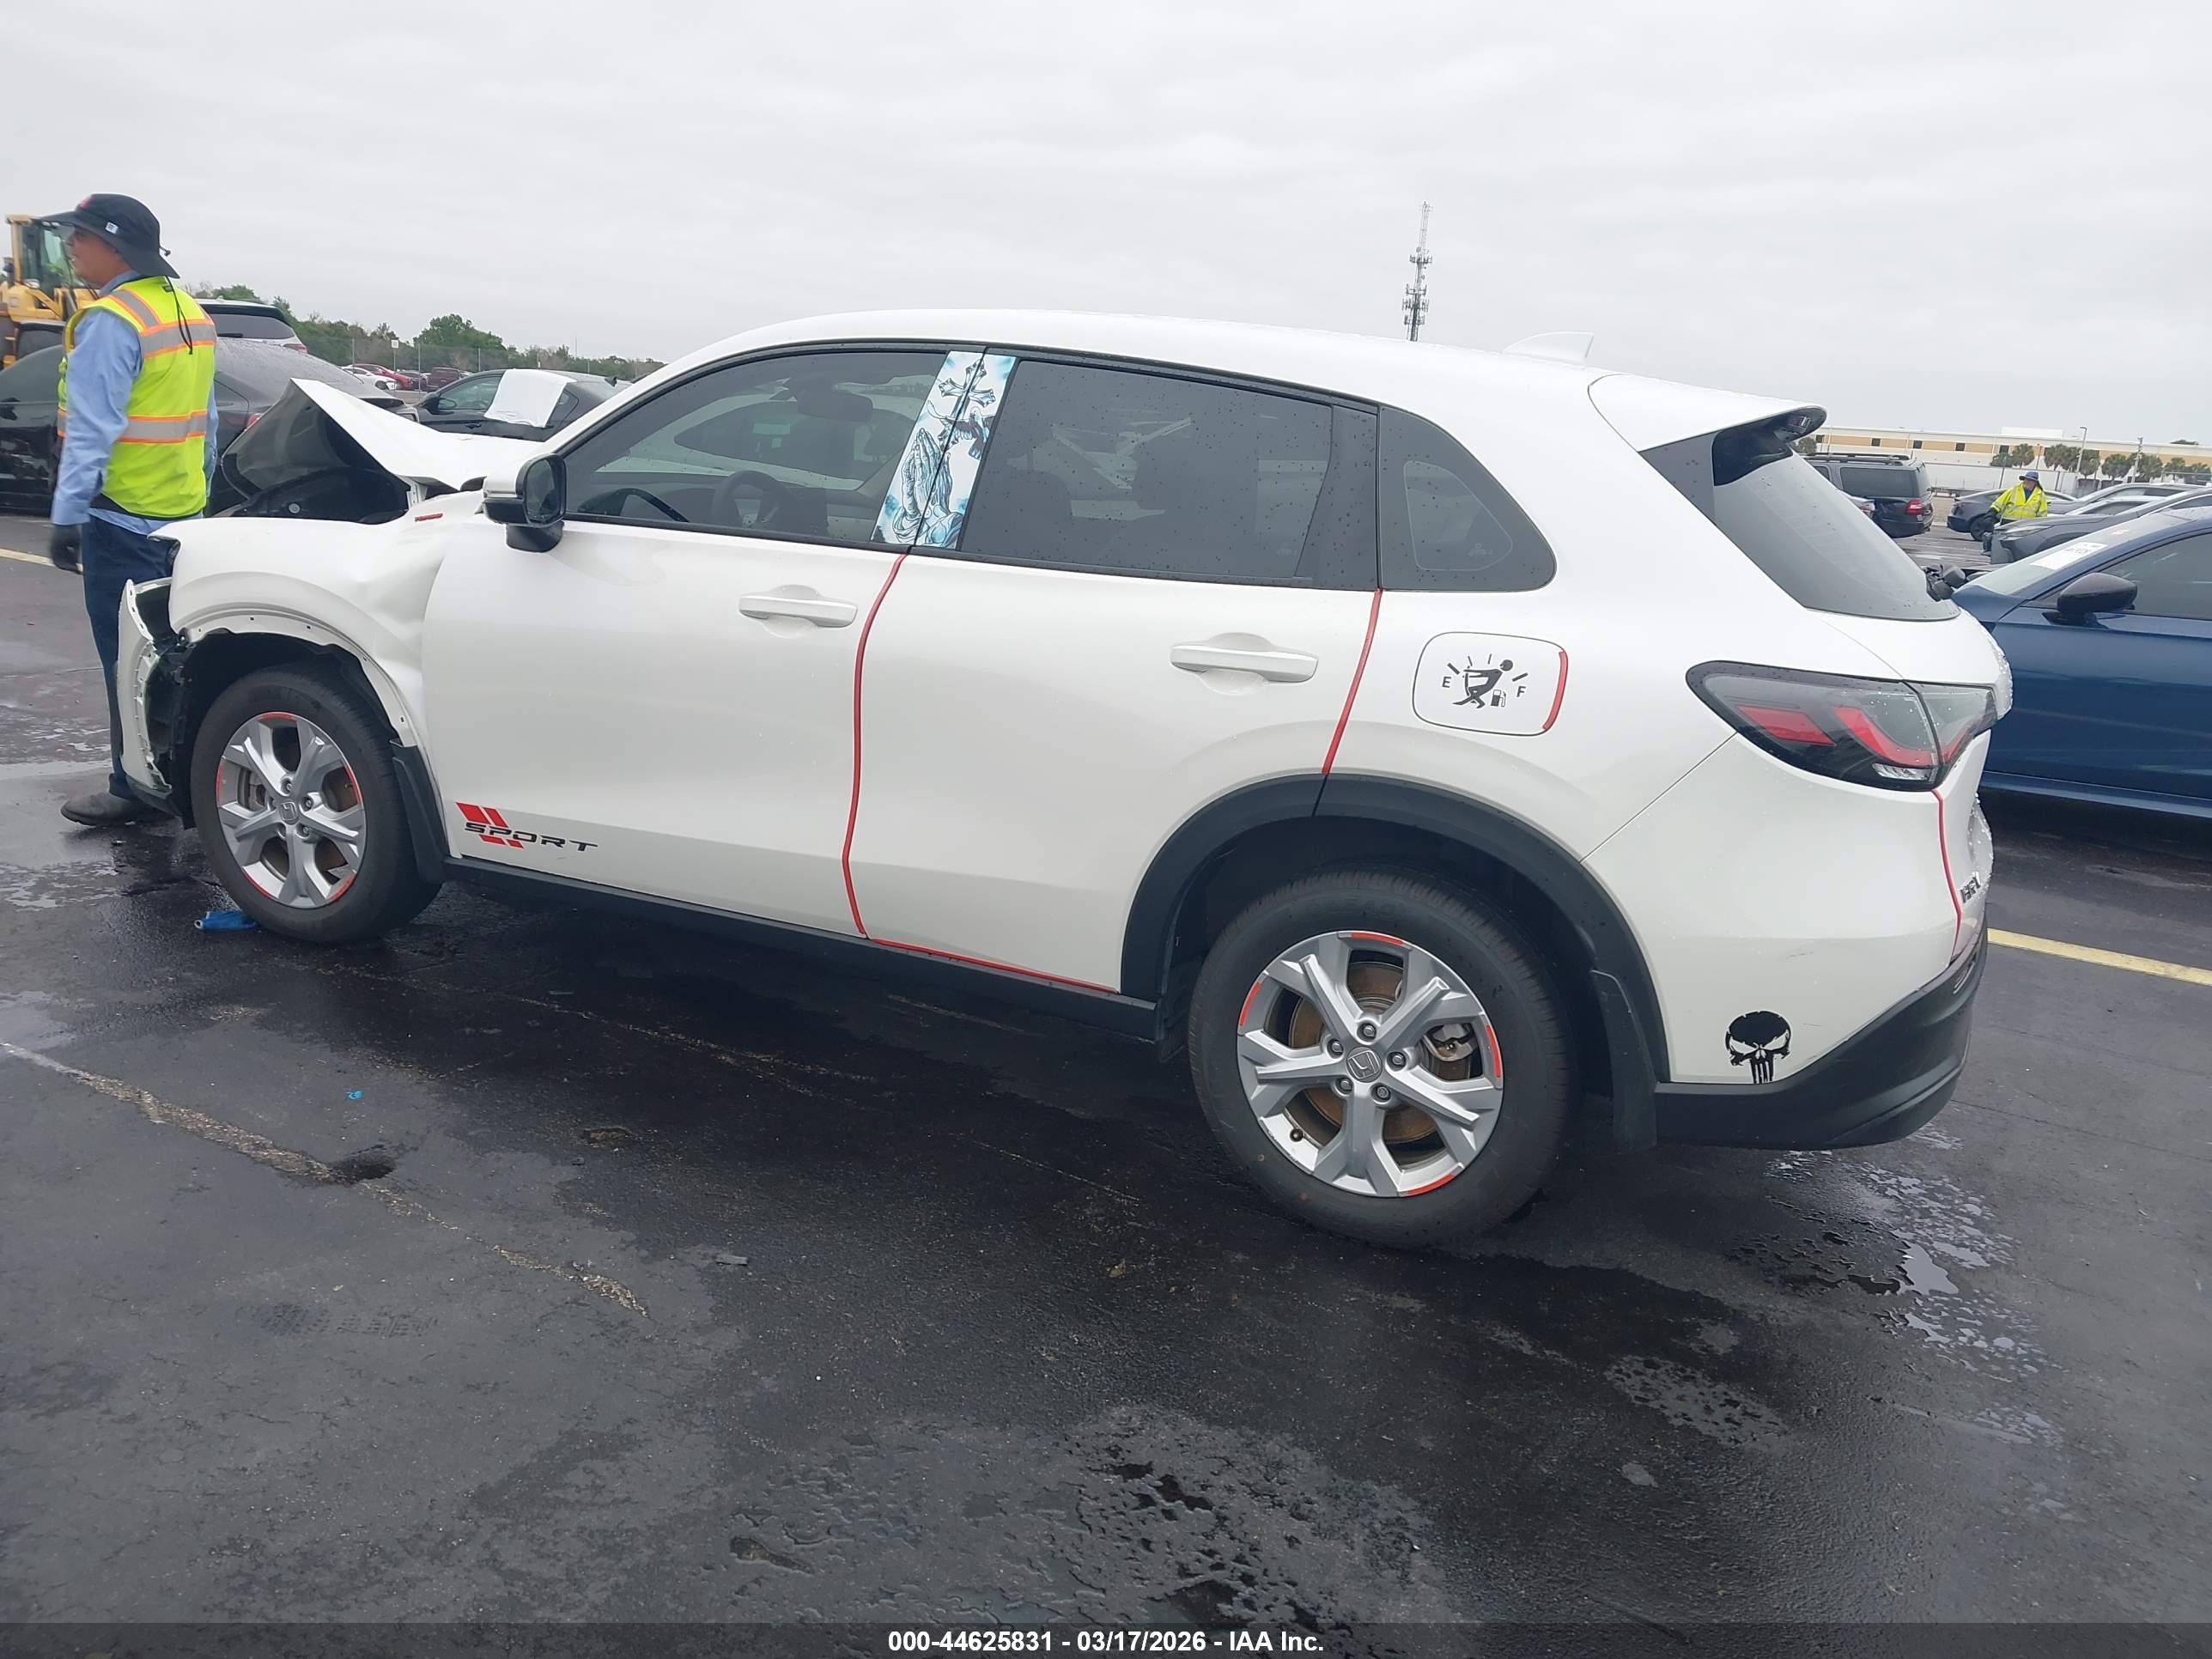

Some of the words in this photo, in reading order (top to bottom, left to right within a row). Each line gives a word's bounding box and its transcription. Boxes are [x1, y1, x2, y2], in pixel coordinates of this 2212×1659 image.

[1442, 676, 1452, 689] E
[1516, 685, 1527, 698] F
[464, 821, 599, 852] SPORT
